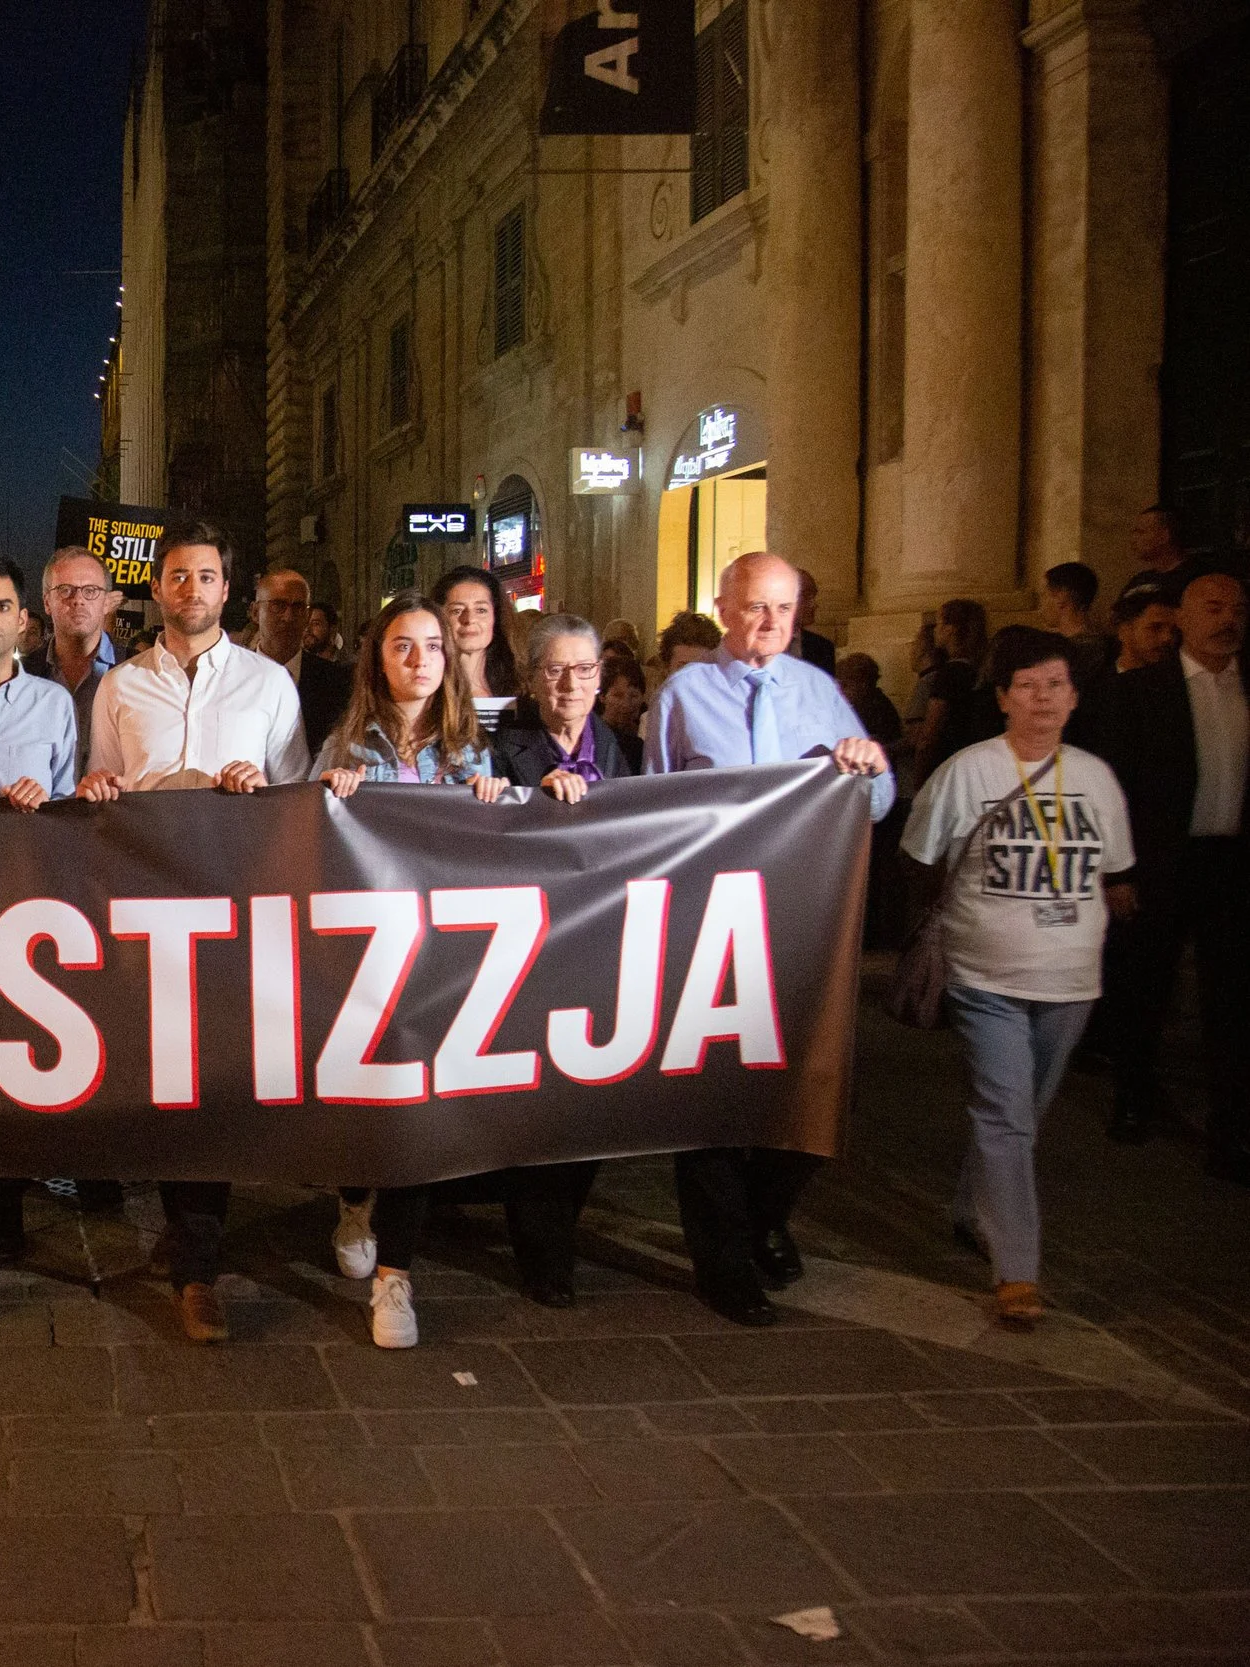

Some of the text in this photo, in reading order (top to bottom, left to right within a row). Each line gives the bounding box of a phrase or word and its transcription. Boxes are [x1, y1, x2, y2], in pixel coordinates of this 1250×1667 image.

[88, 517, 164, 539] THE SITUATION
[409, 513, 465, 523] SUN
[409, 523, 465, 533] LAB
[88, 532, 156, 562] IS STILL
[985, 844, 1101, 893] STATE
